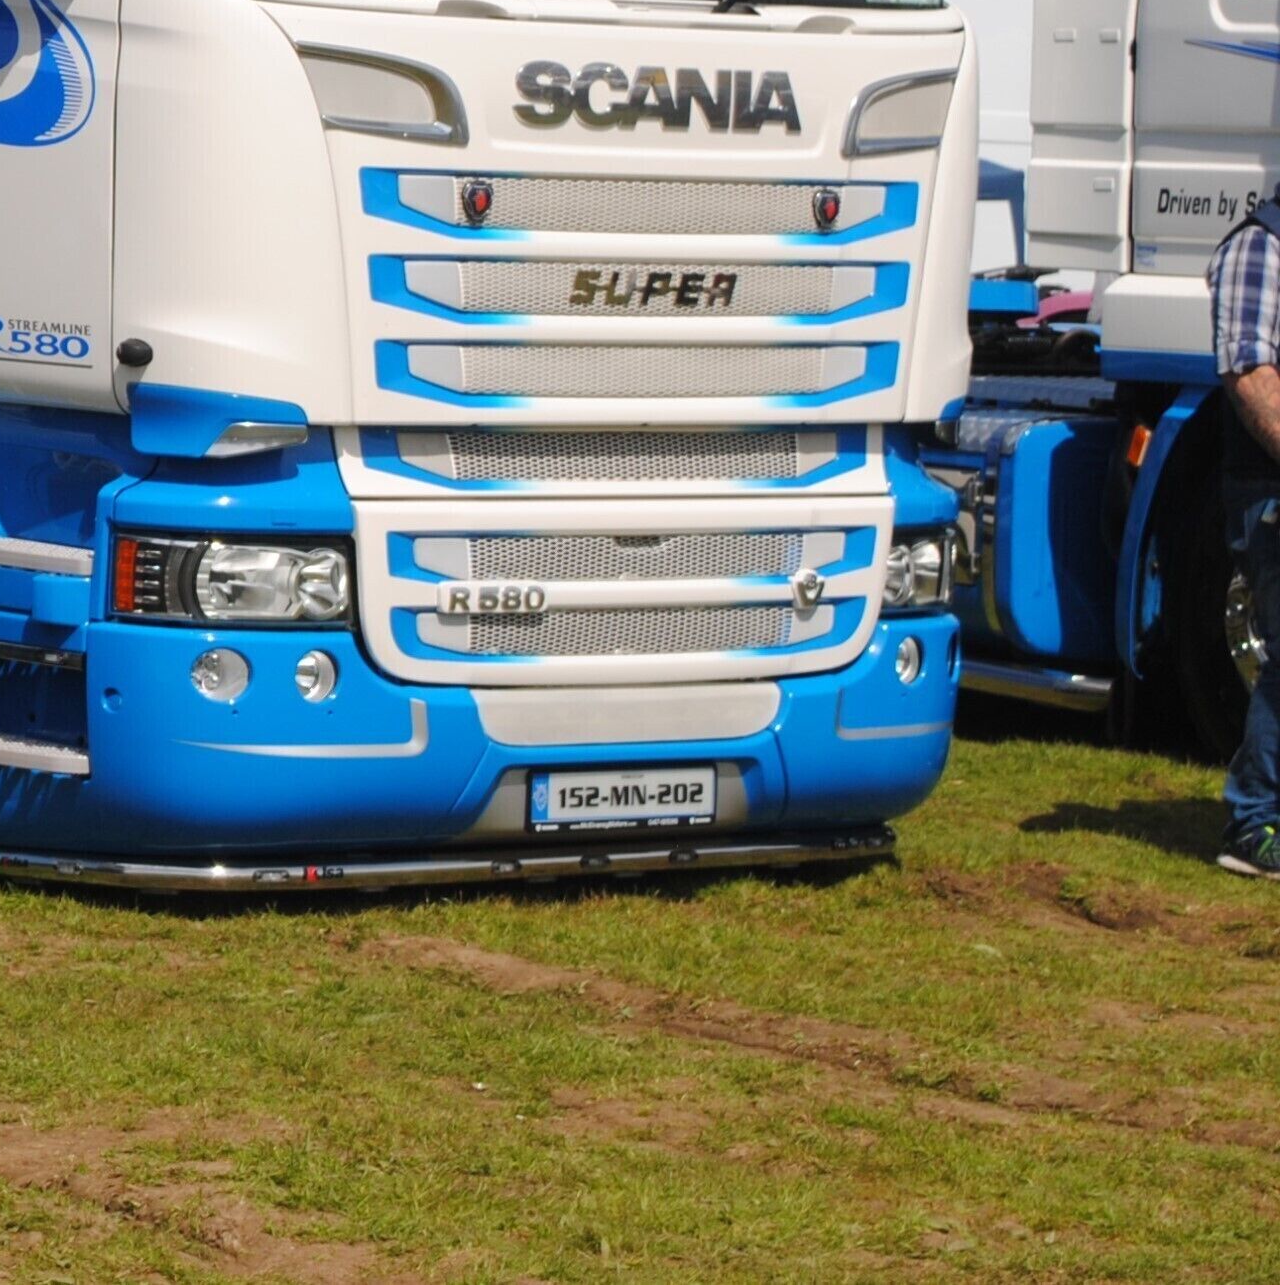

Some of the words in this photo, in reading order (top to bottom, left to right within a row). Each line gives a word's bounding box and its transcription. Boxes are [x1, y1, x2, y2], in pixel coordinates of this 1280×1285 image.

[513, 60, 801, 136] SCANIA
[1158, 188, 1211, 215] Driven
[1218, 191, 1237, 221] by
[569, 270, 738, 307] SUPER
[8, 319, 91, 336] STREAMLINE
[449, 587, 471, 612] R
[478, 585, 545, 611] 580
[559, 783, 703, 809] 152-MN-202
